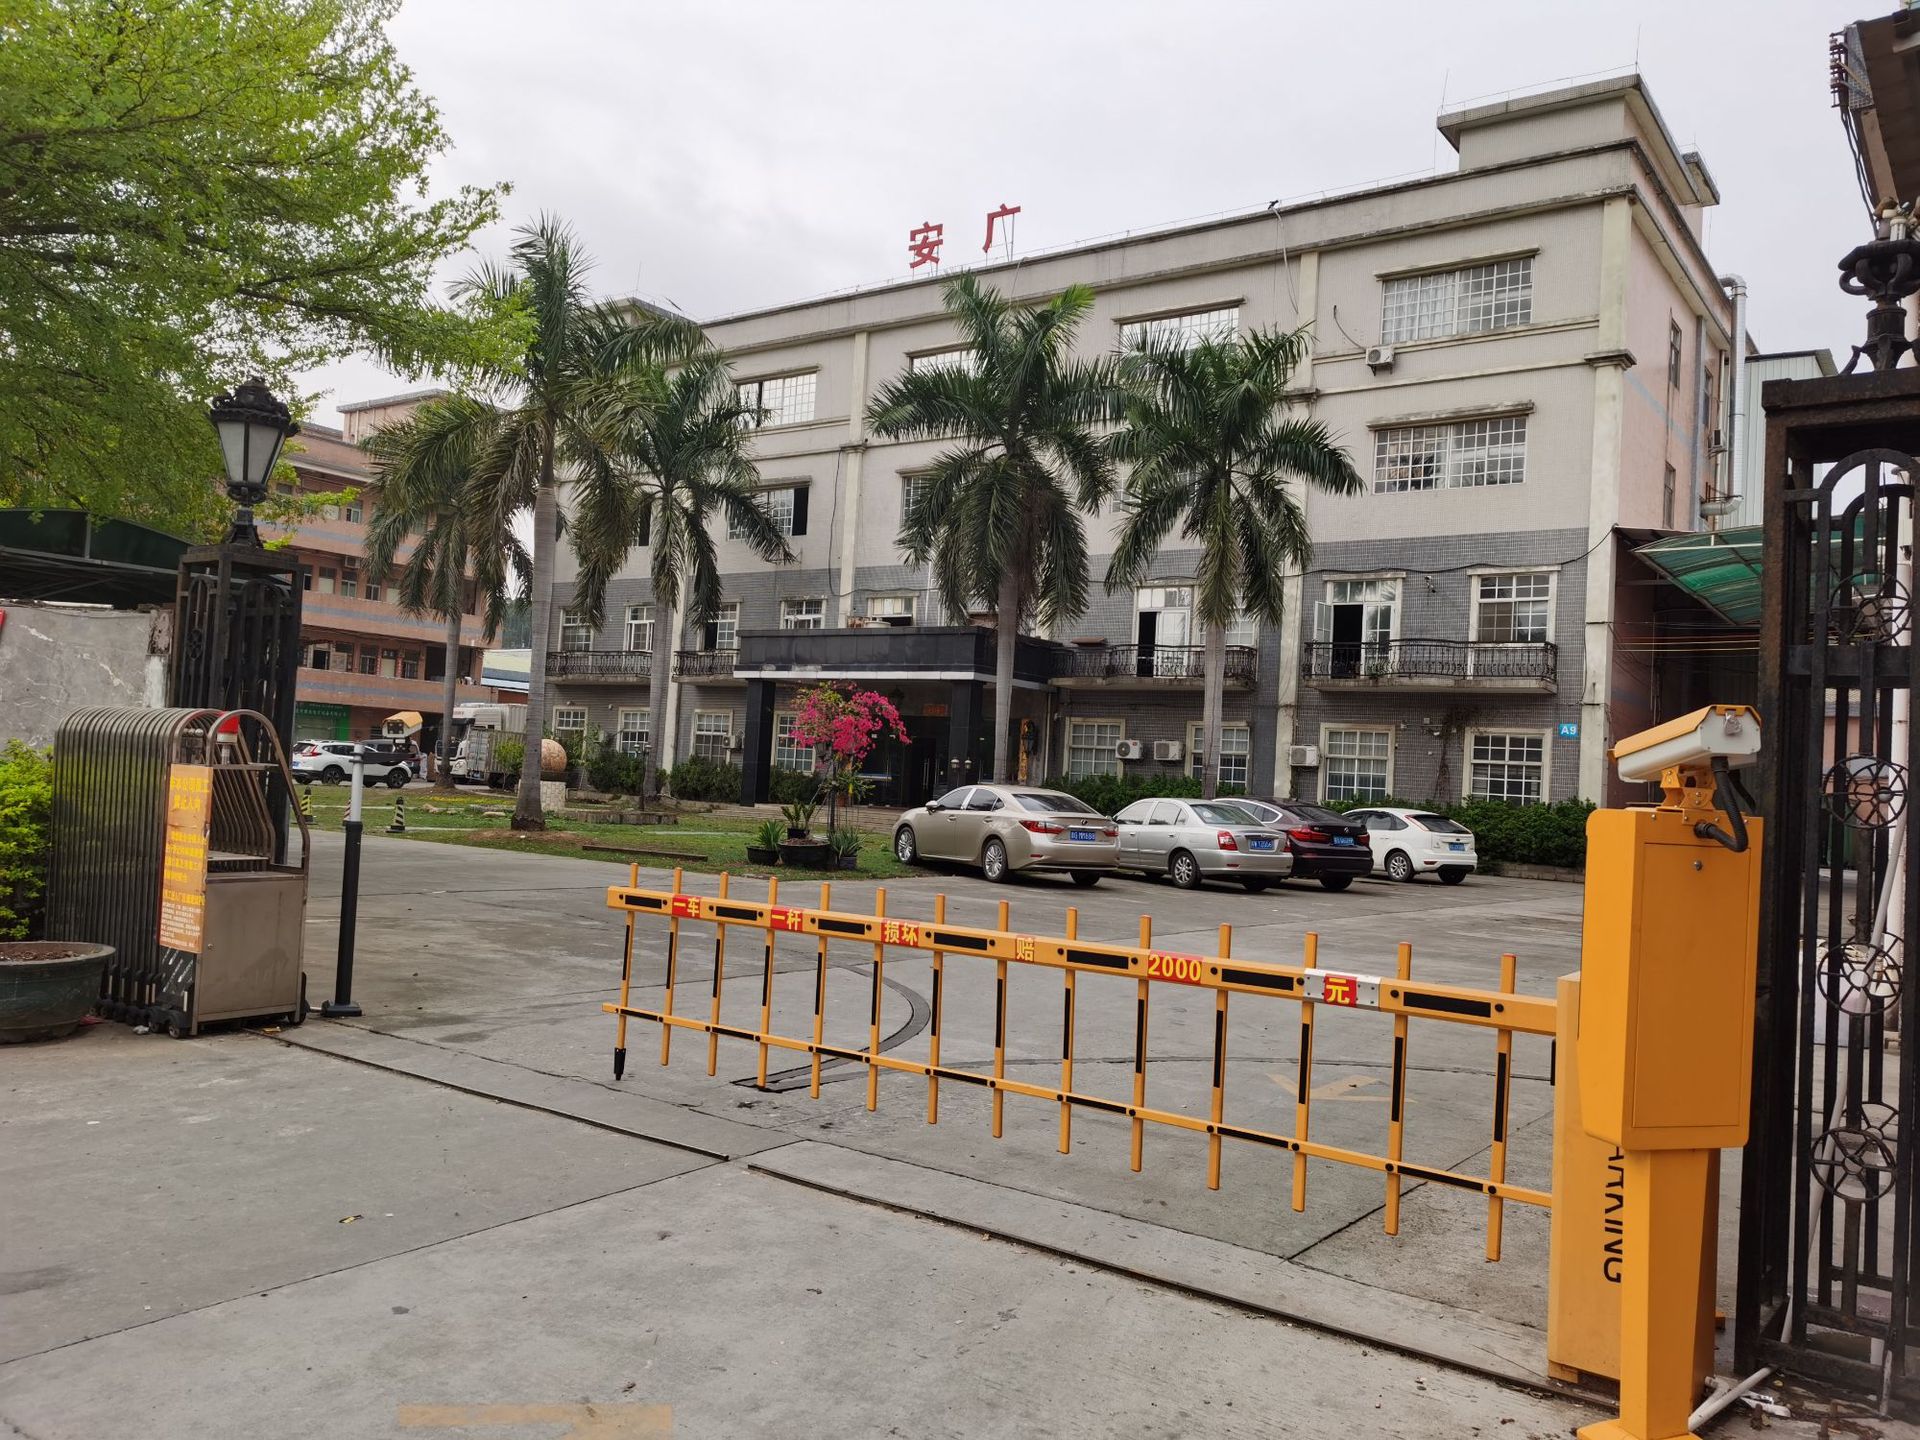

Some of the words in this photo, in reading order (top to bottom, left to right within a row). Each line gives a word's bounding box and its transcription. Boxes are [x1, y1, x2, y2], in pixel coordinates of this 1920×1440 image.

[909, 203, 1021, 268] 安广
[1560, 725, 1578, 736] A9
[673, 897, 701, 918] 一车
[771, 909, 802, 931] 一杆
[884, 920, 919, 946] 损坏
[1016, 936, 1034, 962] 赔
[1148, 954, 1202, 982] 2000
[1325, 977, 1350, 1004] 元
